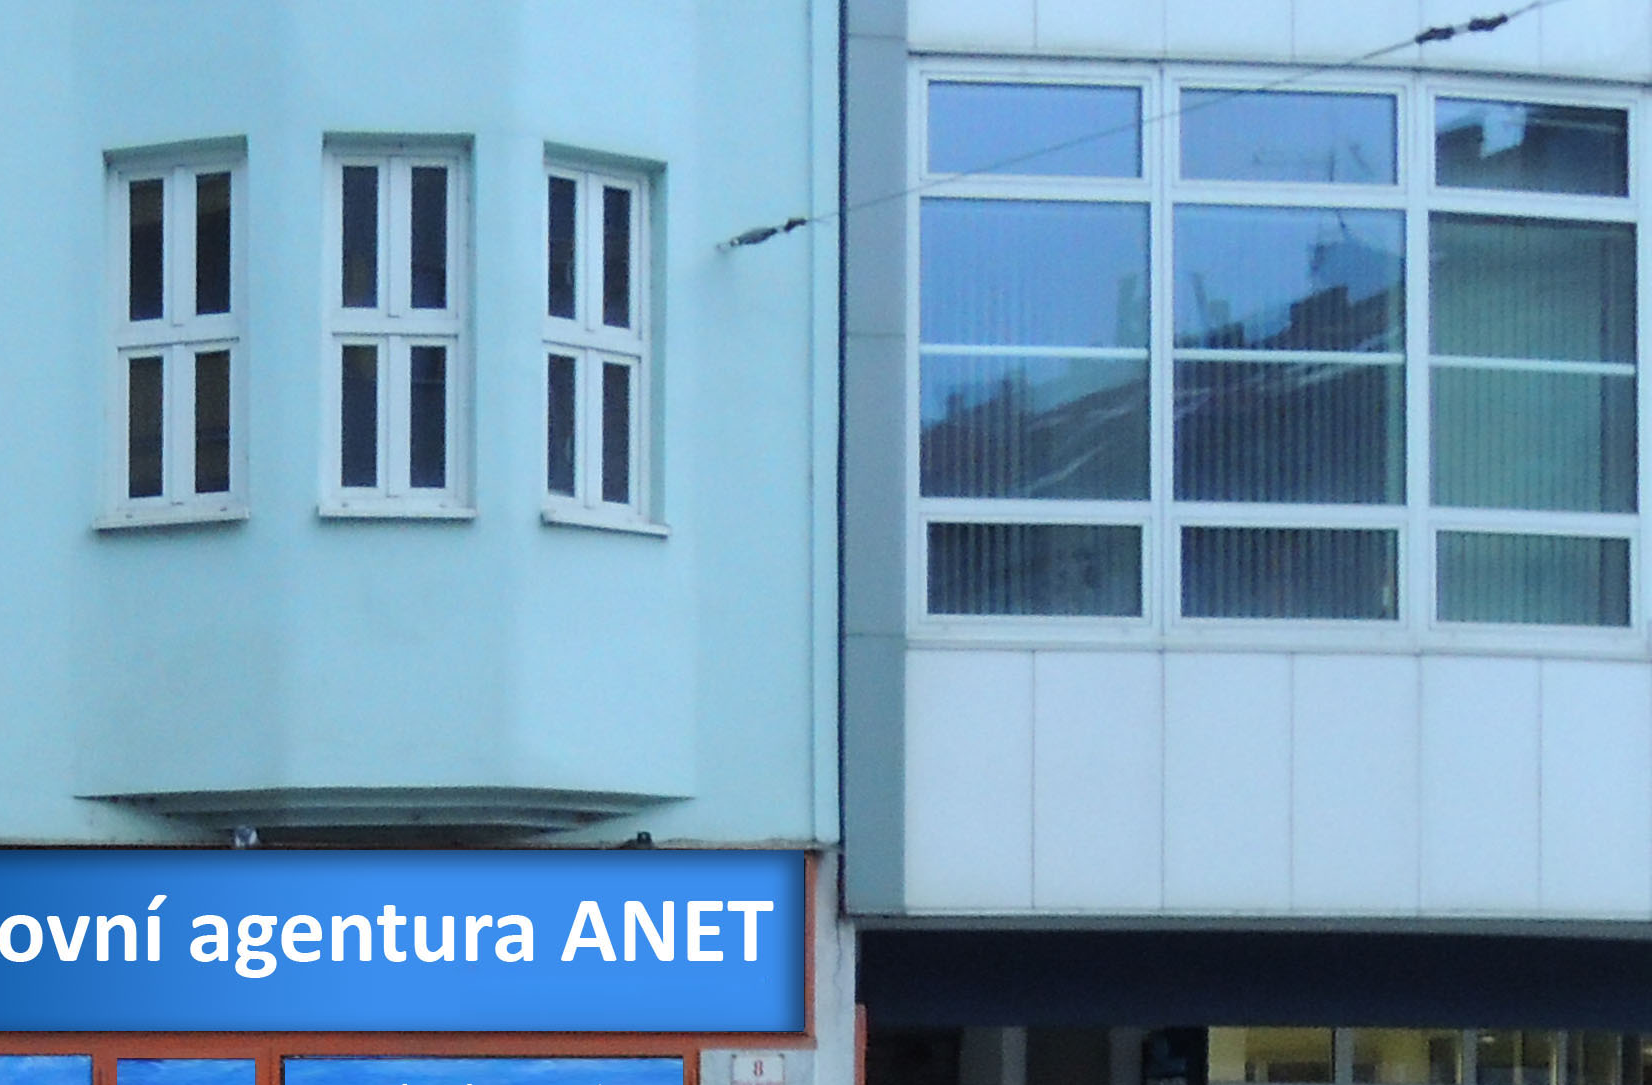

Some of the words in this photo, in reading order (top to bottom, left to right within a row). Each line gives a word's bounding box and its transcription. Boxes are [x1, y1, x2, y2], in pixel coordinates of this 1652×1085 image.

[189, 904, 536, 979] agentura
[560, 900, 775, 962] ANET
[753, 1060, 764, 1077] 8
